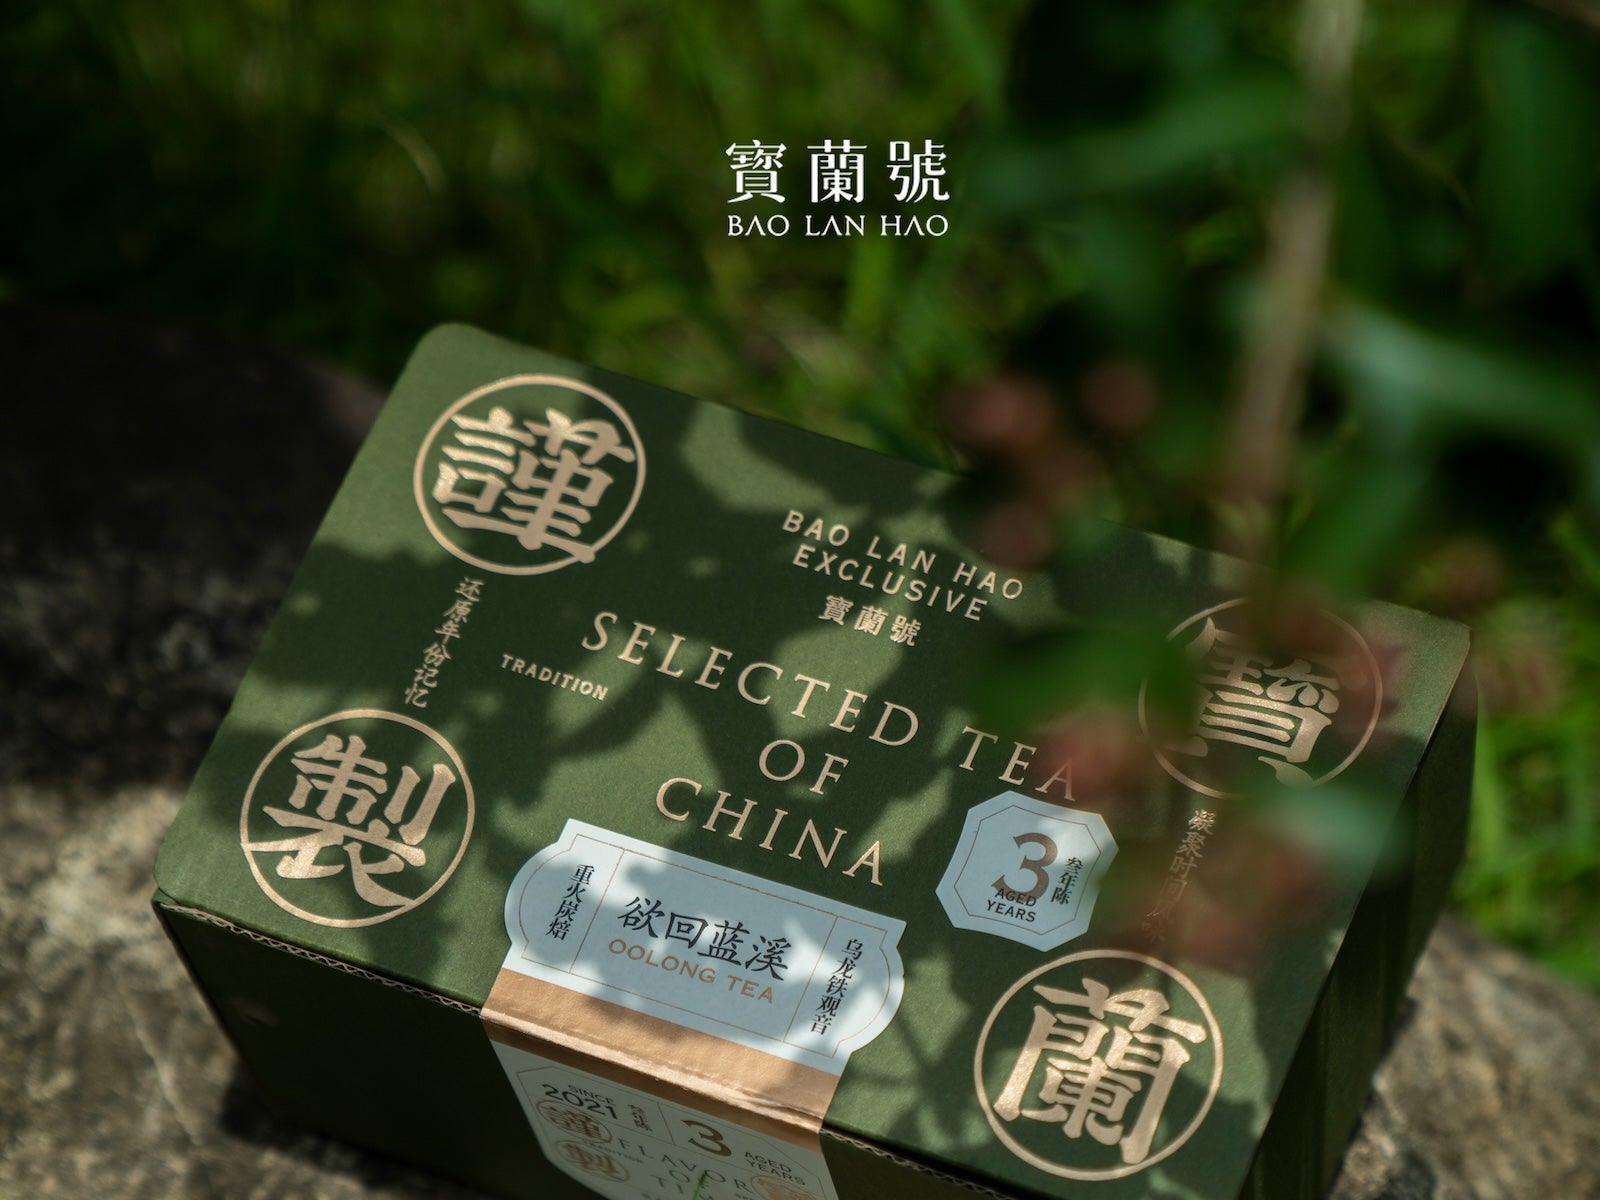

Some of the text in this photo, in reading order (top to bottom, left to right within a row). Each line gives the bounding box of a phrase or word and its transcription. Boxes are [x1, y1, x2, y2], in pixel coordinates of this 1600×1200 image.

[431, 405, 637, 564] 謹
[782, 509, 1023, 600] BAO LAN HAO
[792, 544, 988, 622] EXCLUSIVE
[404, 577, 484, 708] 还原年份记忆
[501, 654, 608, 701] TRADITION
[582, 611, 1077, 802] SELECTED TEA
[759, 739, 849, 796] OF
[242, 734, 457, 908] 製
[655, 777, 884, 886] CHINA
[546, 863, 595, 941] 重火炭焙
[991, 832, 1058, 903] 3
[994, 888, 1037, 907] AGED
[617, 896, 792, 981] 欲回蓝溪
[987, 899, 1037, 922] YEARS
[608, 938, 774, 1004] OOLONG TEA
[810, 937, 863, 1037] 乌龙铁观音
[542, 1084, 618, 1120] 2021
[568, 1084, 616, 1107] SINCE
[993, 977, 1207, 1165] 蘭
[681, 1118, 732, 1157] 3
[744, 1151, 792, 1173] AGED
[746, 1159, 806, 1186] YEARS
